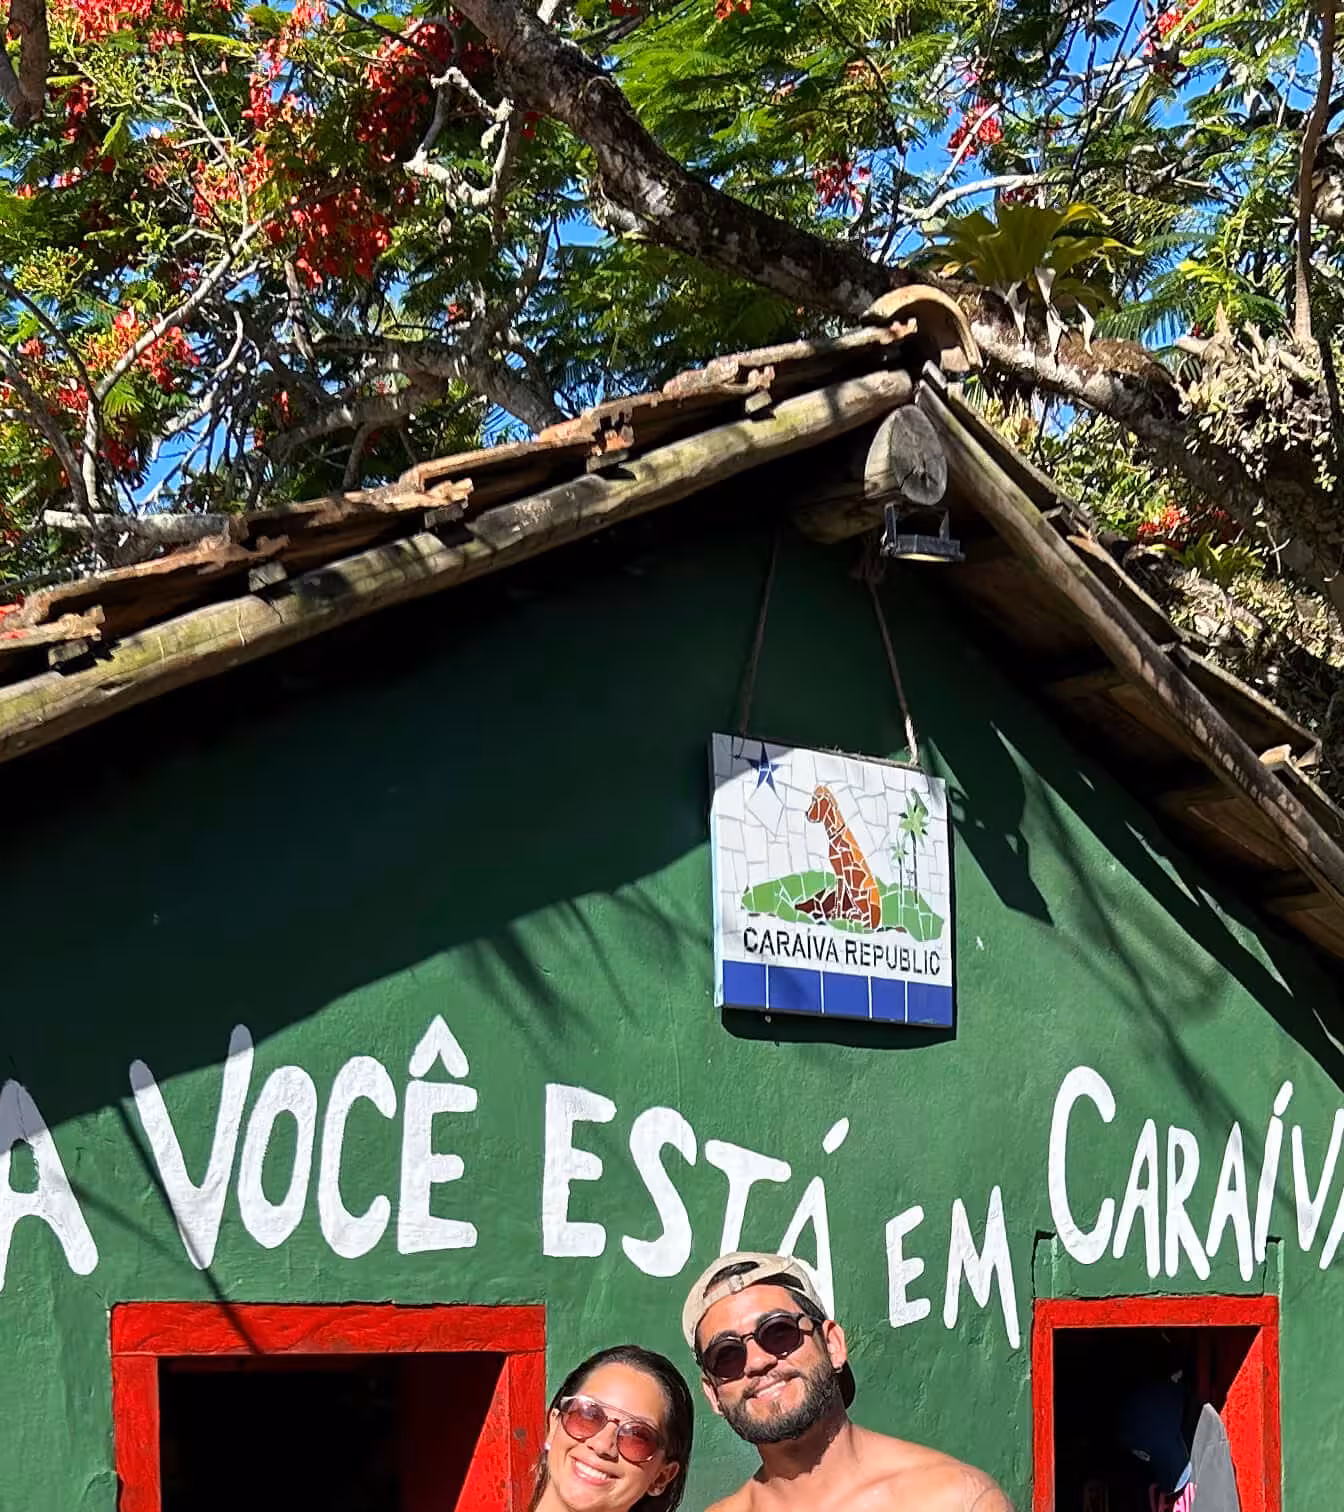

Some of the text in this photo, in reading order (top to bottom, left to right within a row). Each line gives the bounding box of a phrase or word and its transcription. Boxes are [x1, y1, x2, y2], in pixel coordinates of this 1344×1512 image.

[845, 939, 941, 976] REPUBLIC
[129, 1014, 478, 1270] VOCÊ
[542, 1082, 850, 1320] ESTÁ
[885, 1185, 1020, 1350] EM
